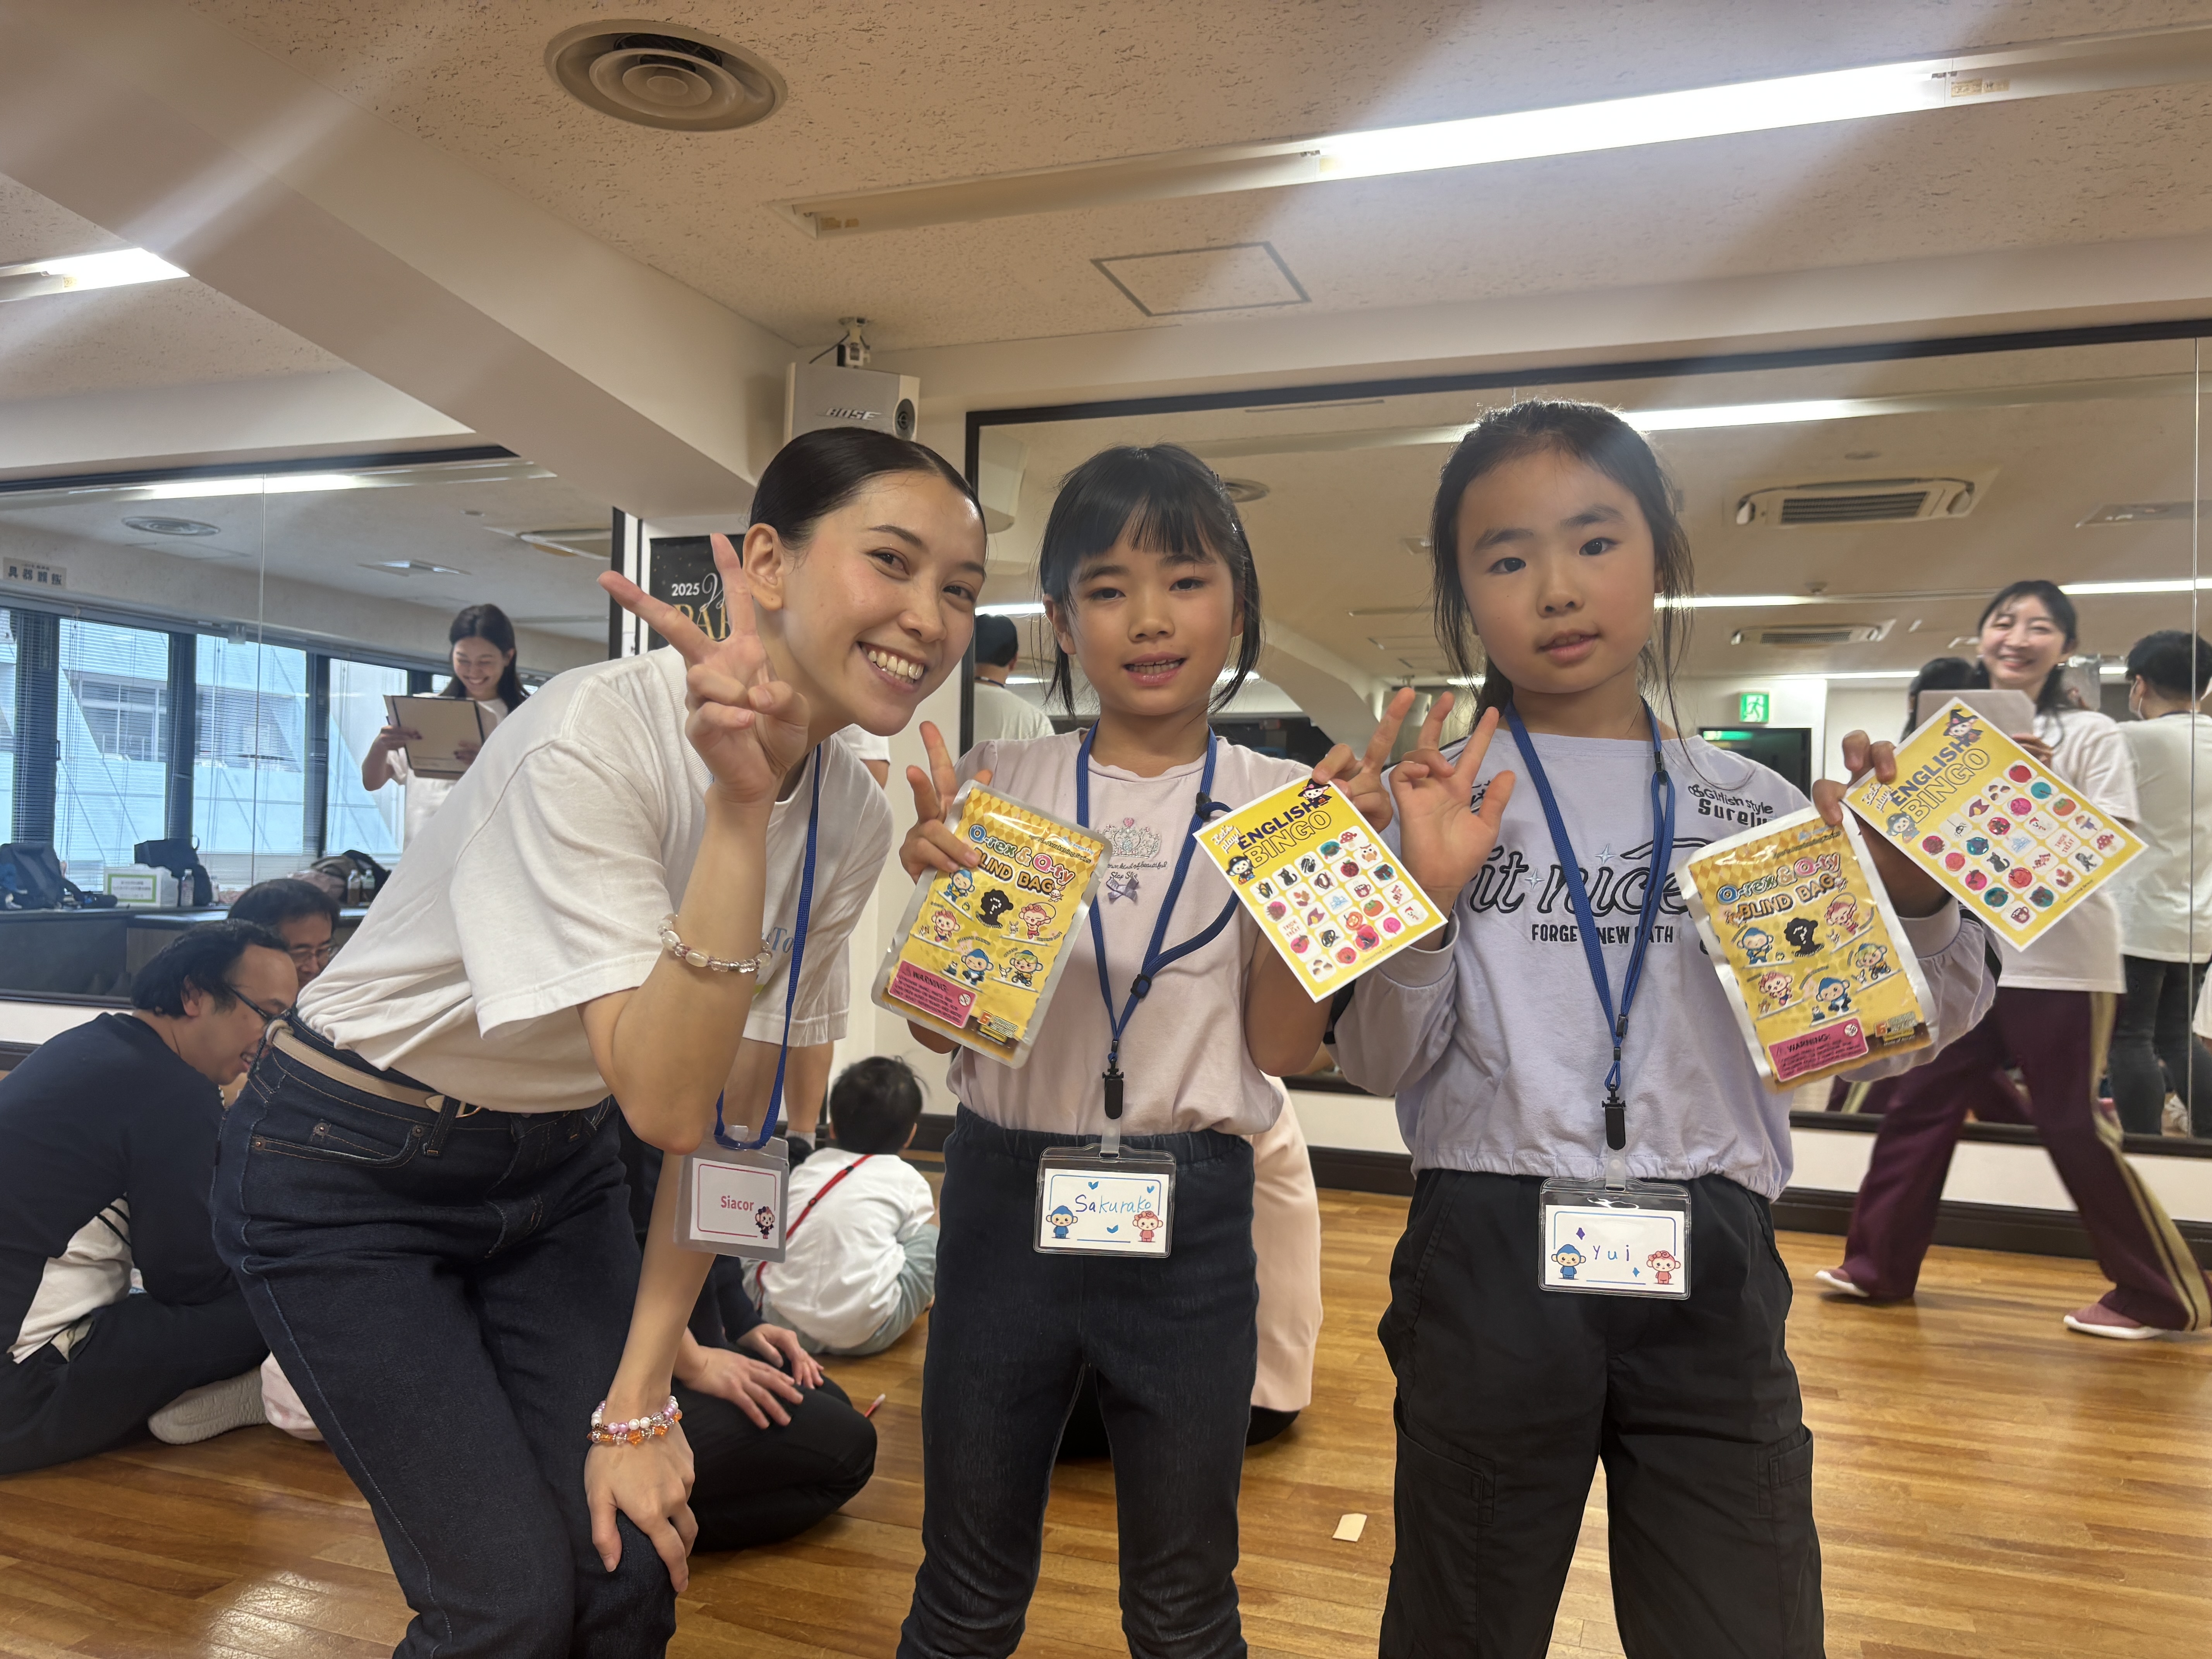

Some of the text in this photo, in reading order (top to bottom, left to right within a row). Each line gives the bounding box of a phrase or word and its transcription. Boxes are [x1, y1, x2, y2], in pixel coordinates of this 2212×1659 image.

[826, 408, 882, 421] BOSE
[672, 583, 700, 596] 2025
[1890, 739, 1972, 807] ENGLISH
[1900, 748, 1990, 823] BINGO
[1745, 799, 1773, 815] style
[1211, 825, 1234, 846] Let's
[1238, 802, 1319, 850] ENGLISH
[1221, 827, 1242, 854] play!
[1243, 811, 1331, 868] BINGO
[969, 824, 1018, 857] Q-rex
[1015, 846, 1032, 867] &
[1032, 852, 1075, 885] Q-ty
[1017, 871, 1054, 895] BAG
[1717, 852, 1841, 905] Q-rex & Q-ty
[1737, 873, 1835, 919] BLIND BAG
[1532, 924, 1578, 942] FORGE
[1596, 926, 1630, 944] NEW
[721, 1195, 754, 1211] Siacor
[1075, 1194, 1151, 1213] Sakurako
